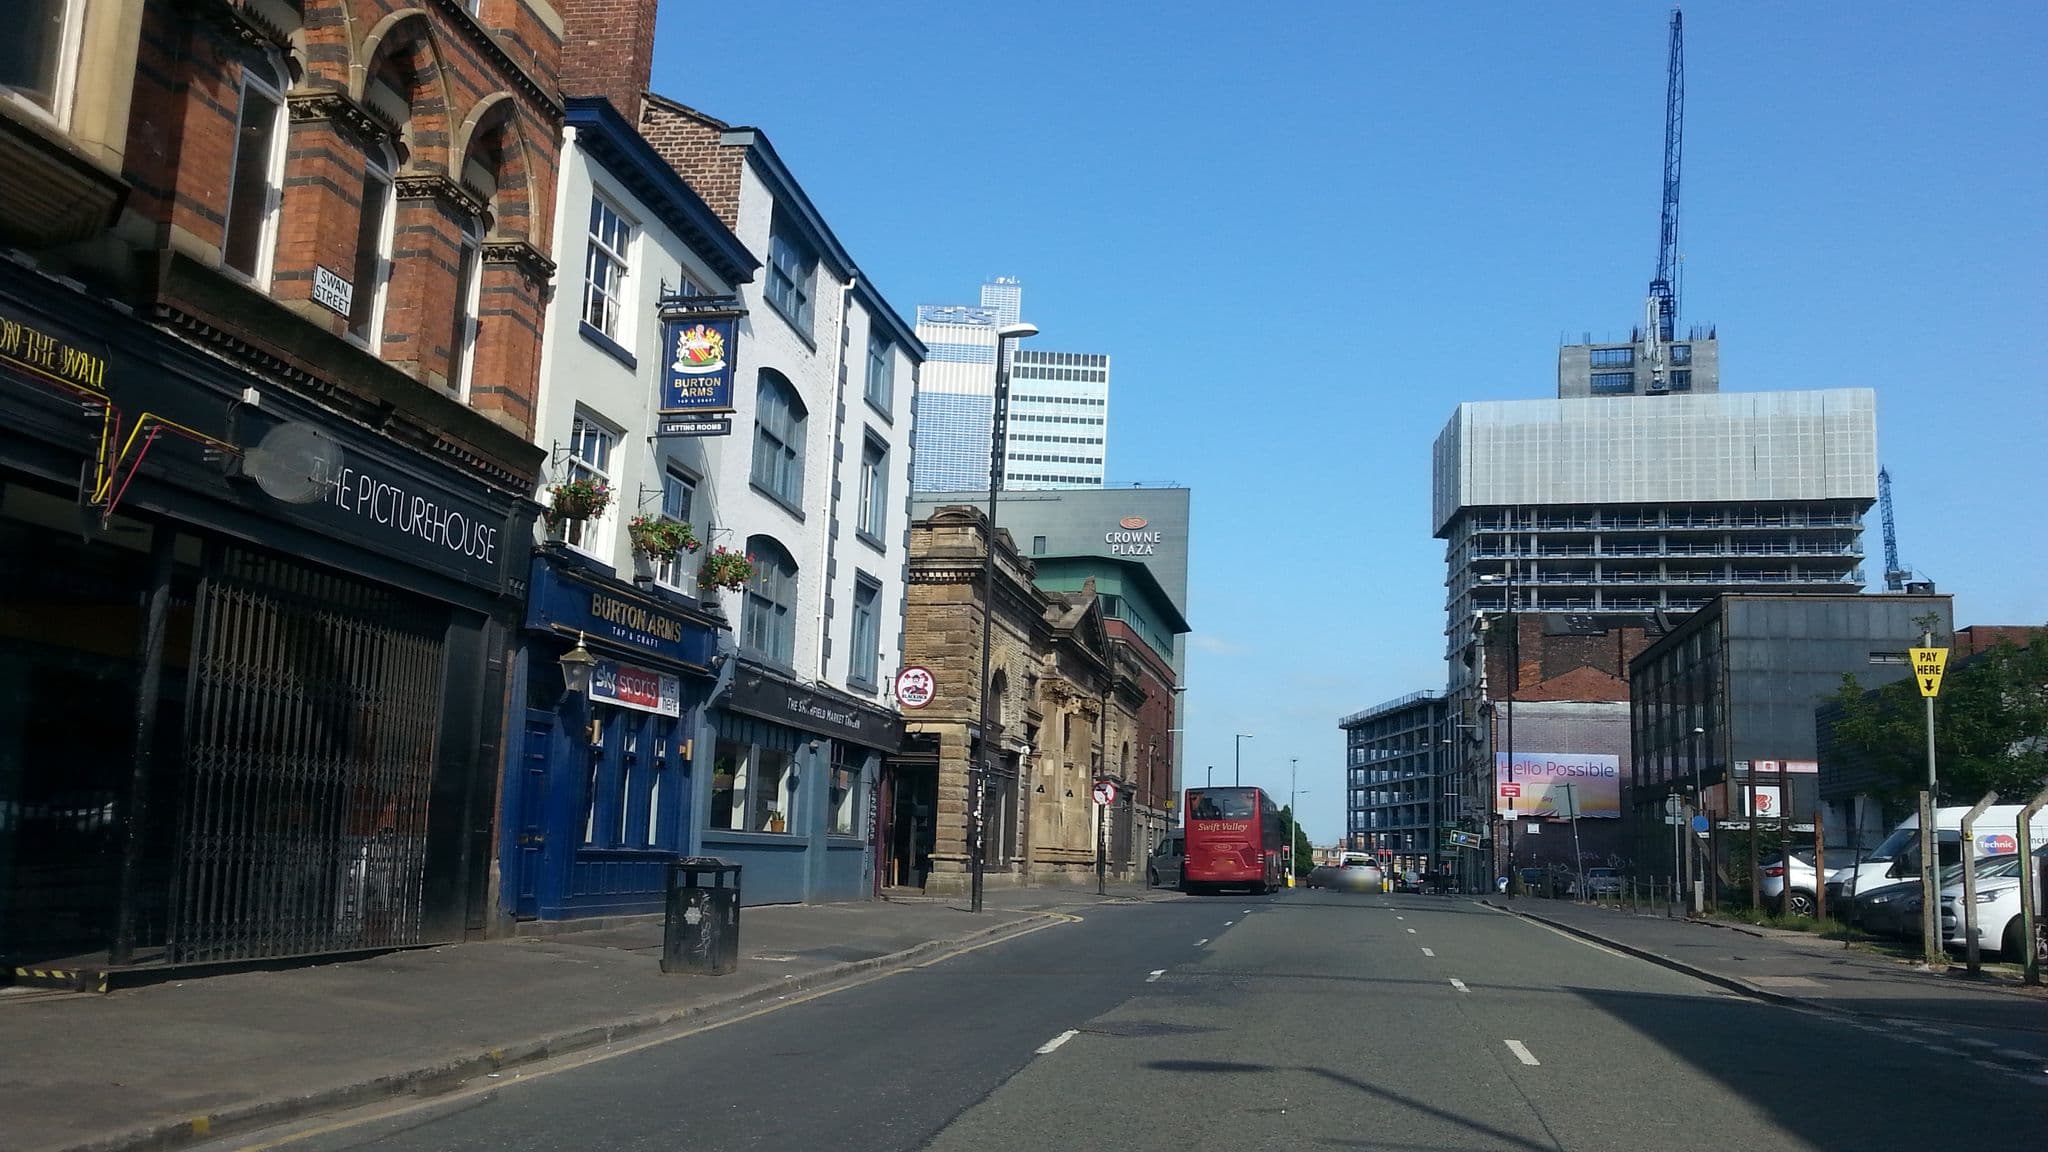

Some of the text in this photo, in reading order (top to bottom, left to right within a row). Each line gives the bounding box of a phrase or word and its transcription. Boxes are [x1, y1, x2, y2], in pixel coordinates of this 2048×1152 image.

[321, 271, 348, 297] SWAN
[315, 284, 349, 313] STREET
[23, 326, 59, 369] THE
[60, 344, 105, 390] WALL
[674, 377, 721, 388] BURTON
[681, 387, 714, 397] ARMS
[667, 423, 722, 432] LETTING ROOMS
[357, 475, 496, 564] PICTUREHOUSE
[1105, 531, 1161, 543] CROWNE
[1111, 544, 1153, 555] PLAZA
[591, 593, 682, 643] BURTON ARMS
[612, 626, 659, 648] TAP & CRAFT
[1920, 652, 1937, 662] PAY
[1917, 664, 1941, 675] HERE
[596, 665, 657, 700] sky sports
[662, 697, 677, 712] here
[1500, 761, 1614, 777] Hello Possible
[1198, 823, 1248, 832] Swift Valley
